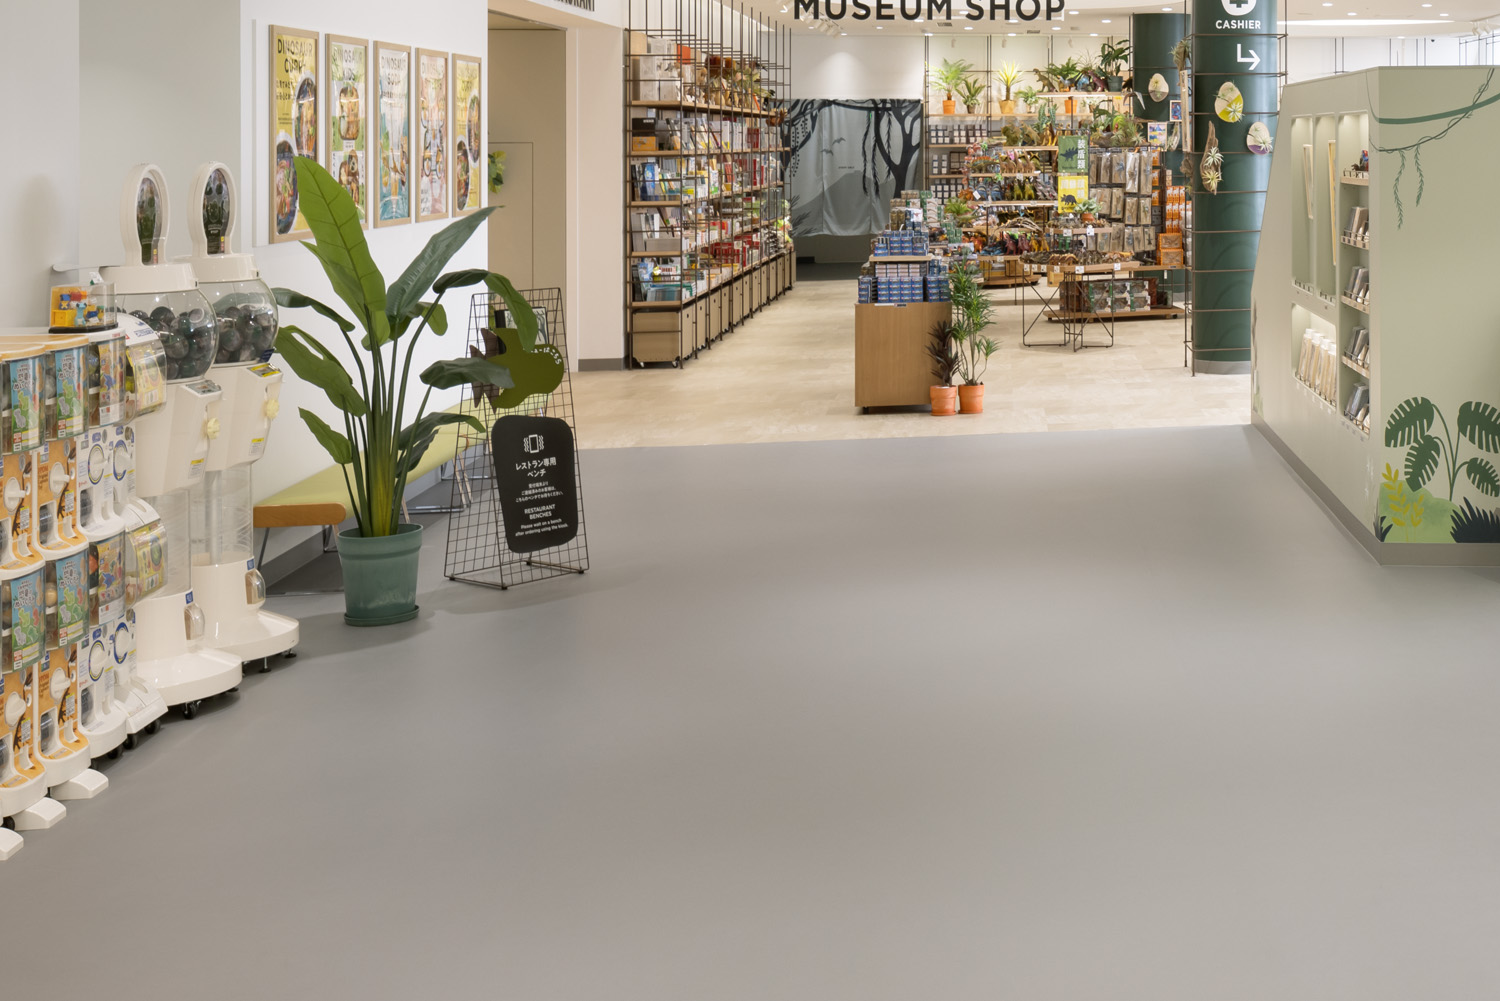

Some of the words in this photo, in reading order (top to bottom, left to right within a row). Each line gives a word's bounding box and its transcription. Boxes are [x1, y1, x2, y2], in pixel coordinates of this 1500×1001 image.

[1215, 19, 1262, 30] CASHIER
[515, 456, 557, 471] レストラン専用
[527, 468, 547, 478] ベンチ
[524, 503, 556, 514] RESTAURANT
[529, 510, 552, 520] BENCHES
